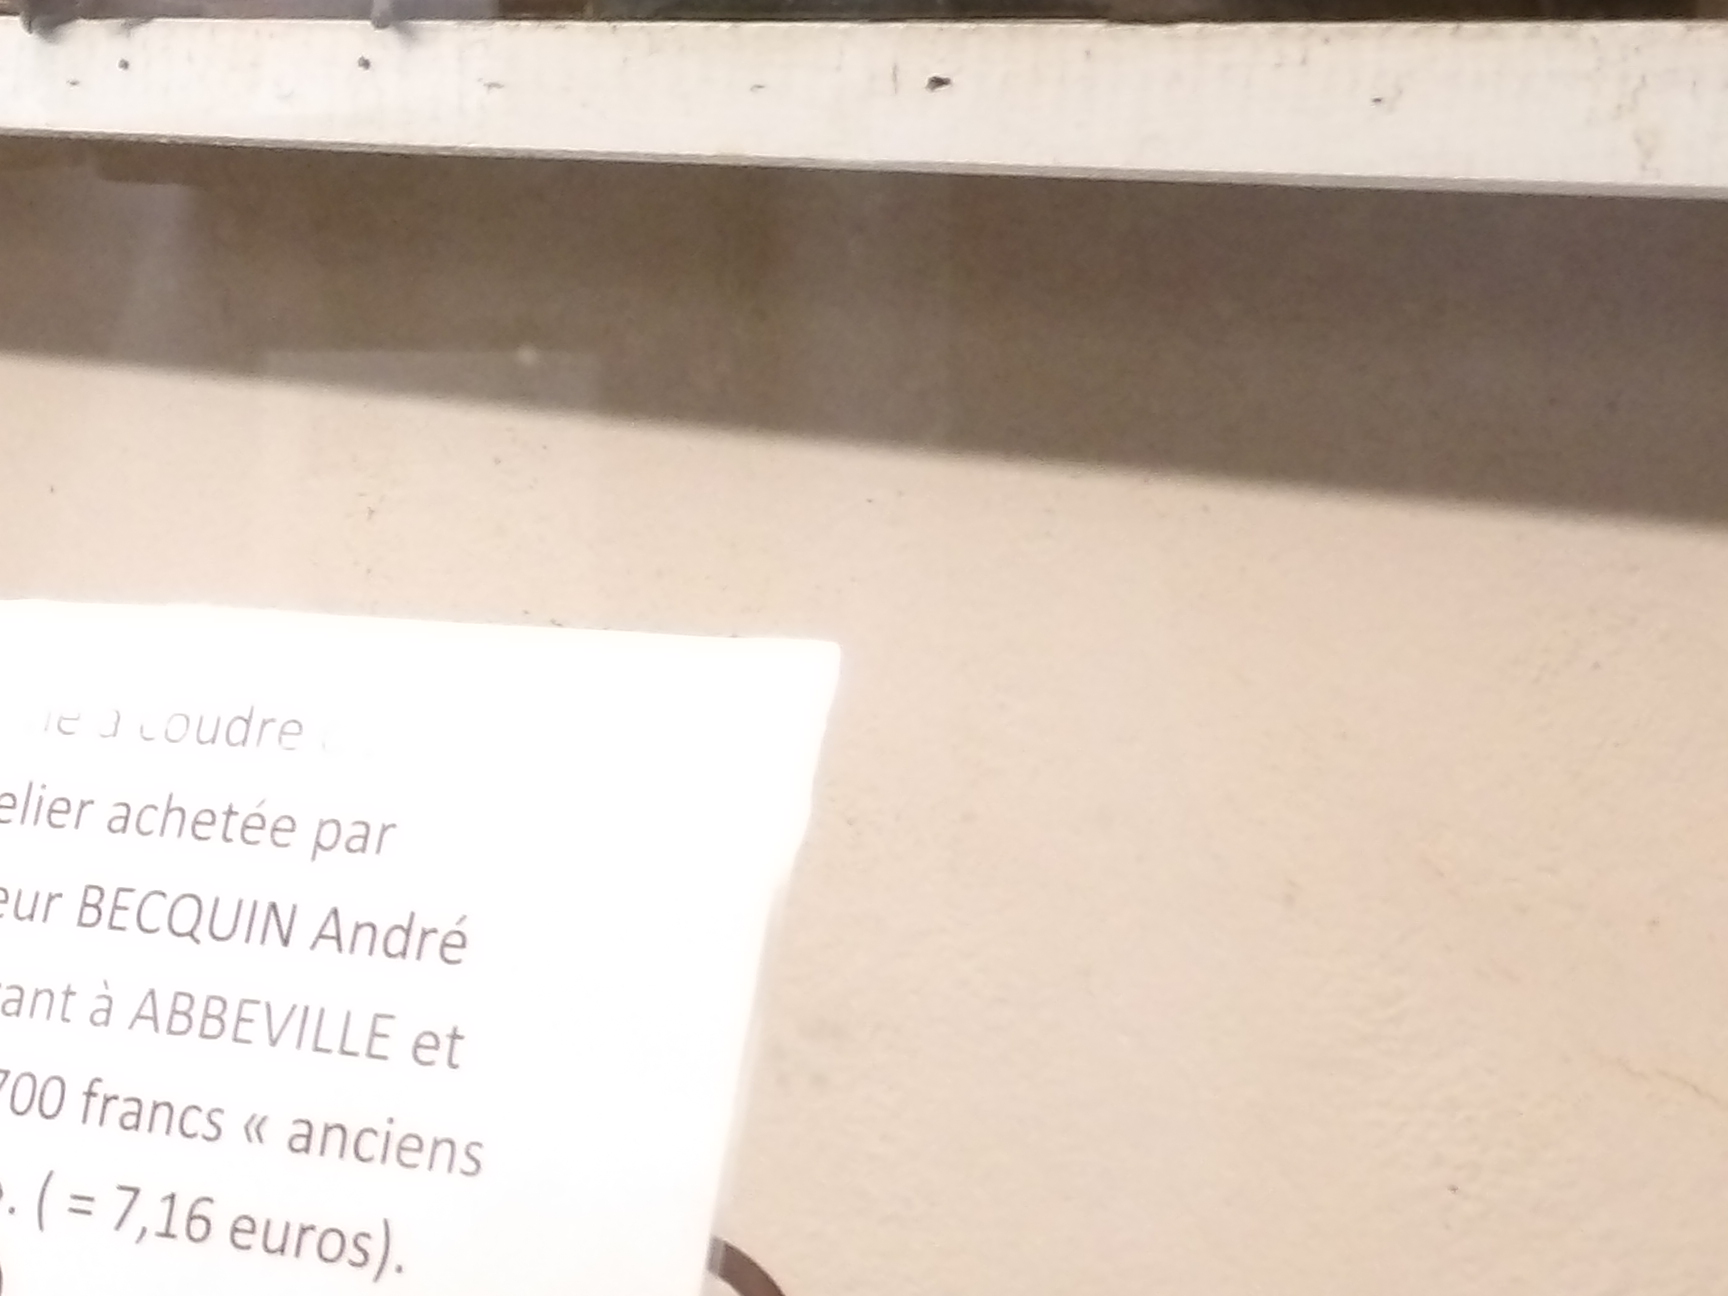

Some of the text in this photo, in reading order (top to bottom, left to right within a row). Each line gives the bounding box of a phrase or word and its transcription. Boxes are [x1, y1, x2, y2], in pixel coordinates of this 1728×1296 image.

[106, 791, 297, 849] achetée
[310, 818, 398, 863] par
[76, 883, 298, 948] BECQUIN
[309, 906, 468, 966] André
[88, 979, 114, 1028] à
[127, 987, 397, 1061] ABBEVILLE
[411, 1025, 466, 1070] et
[81, 1078, 225, 1145] francs
[286, 1116, 484, 1178] anciens
[113, 1183, 215, 1245] 7,16
[228, 1213, 404, 1284] euros).
